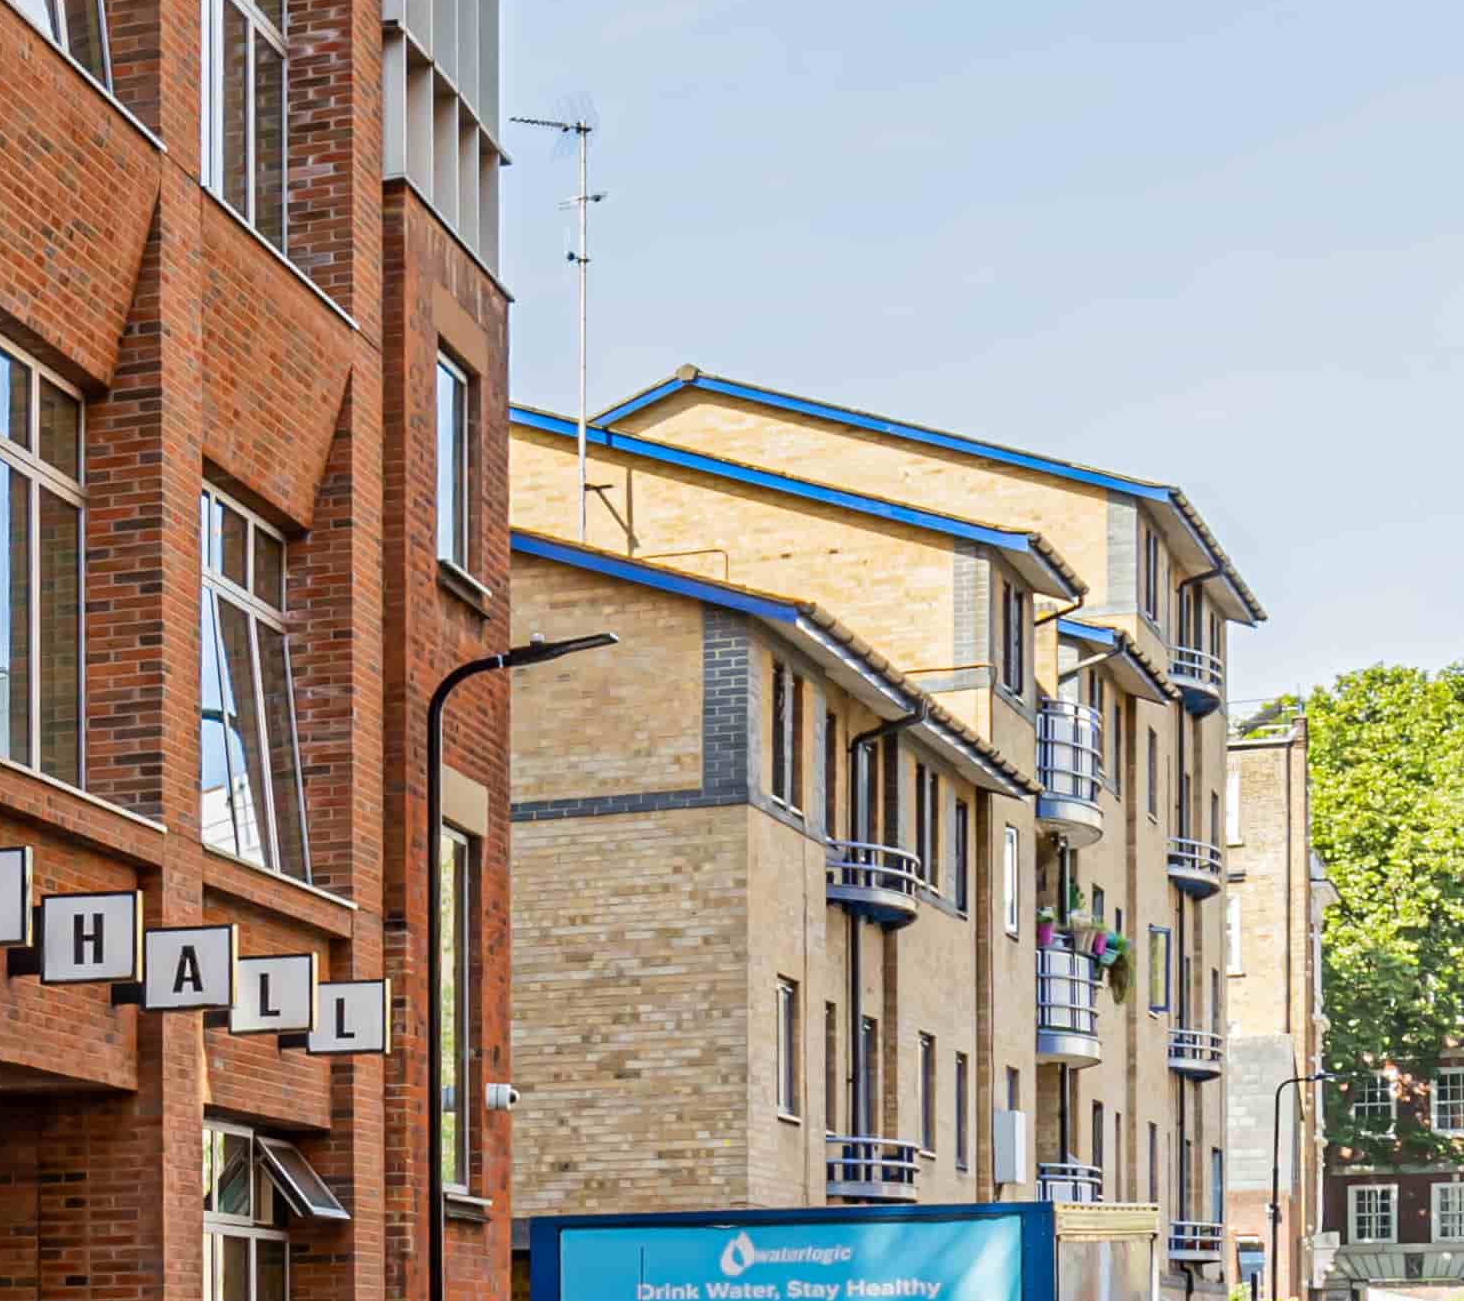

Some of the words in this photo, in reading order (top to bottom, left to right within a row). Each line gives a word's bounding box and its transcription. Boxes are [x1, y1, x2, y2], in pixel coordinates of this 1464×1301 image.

[753, 1245, 853, 1265] waterlogic
[637, 1282, 699, 1301] Drink
[706, 1282, 780, 1300] Water,
[787, 1279, 840, 1301] Stay
[847, 1277, 941, 1300] Healthy
